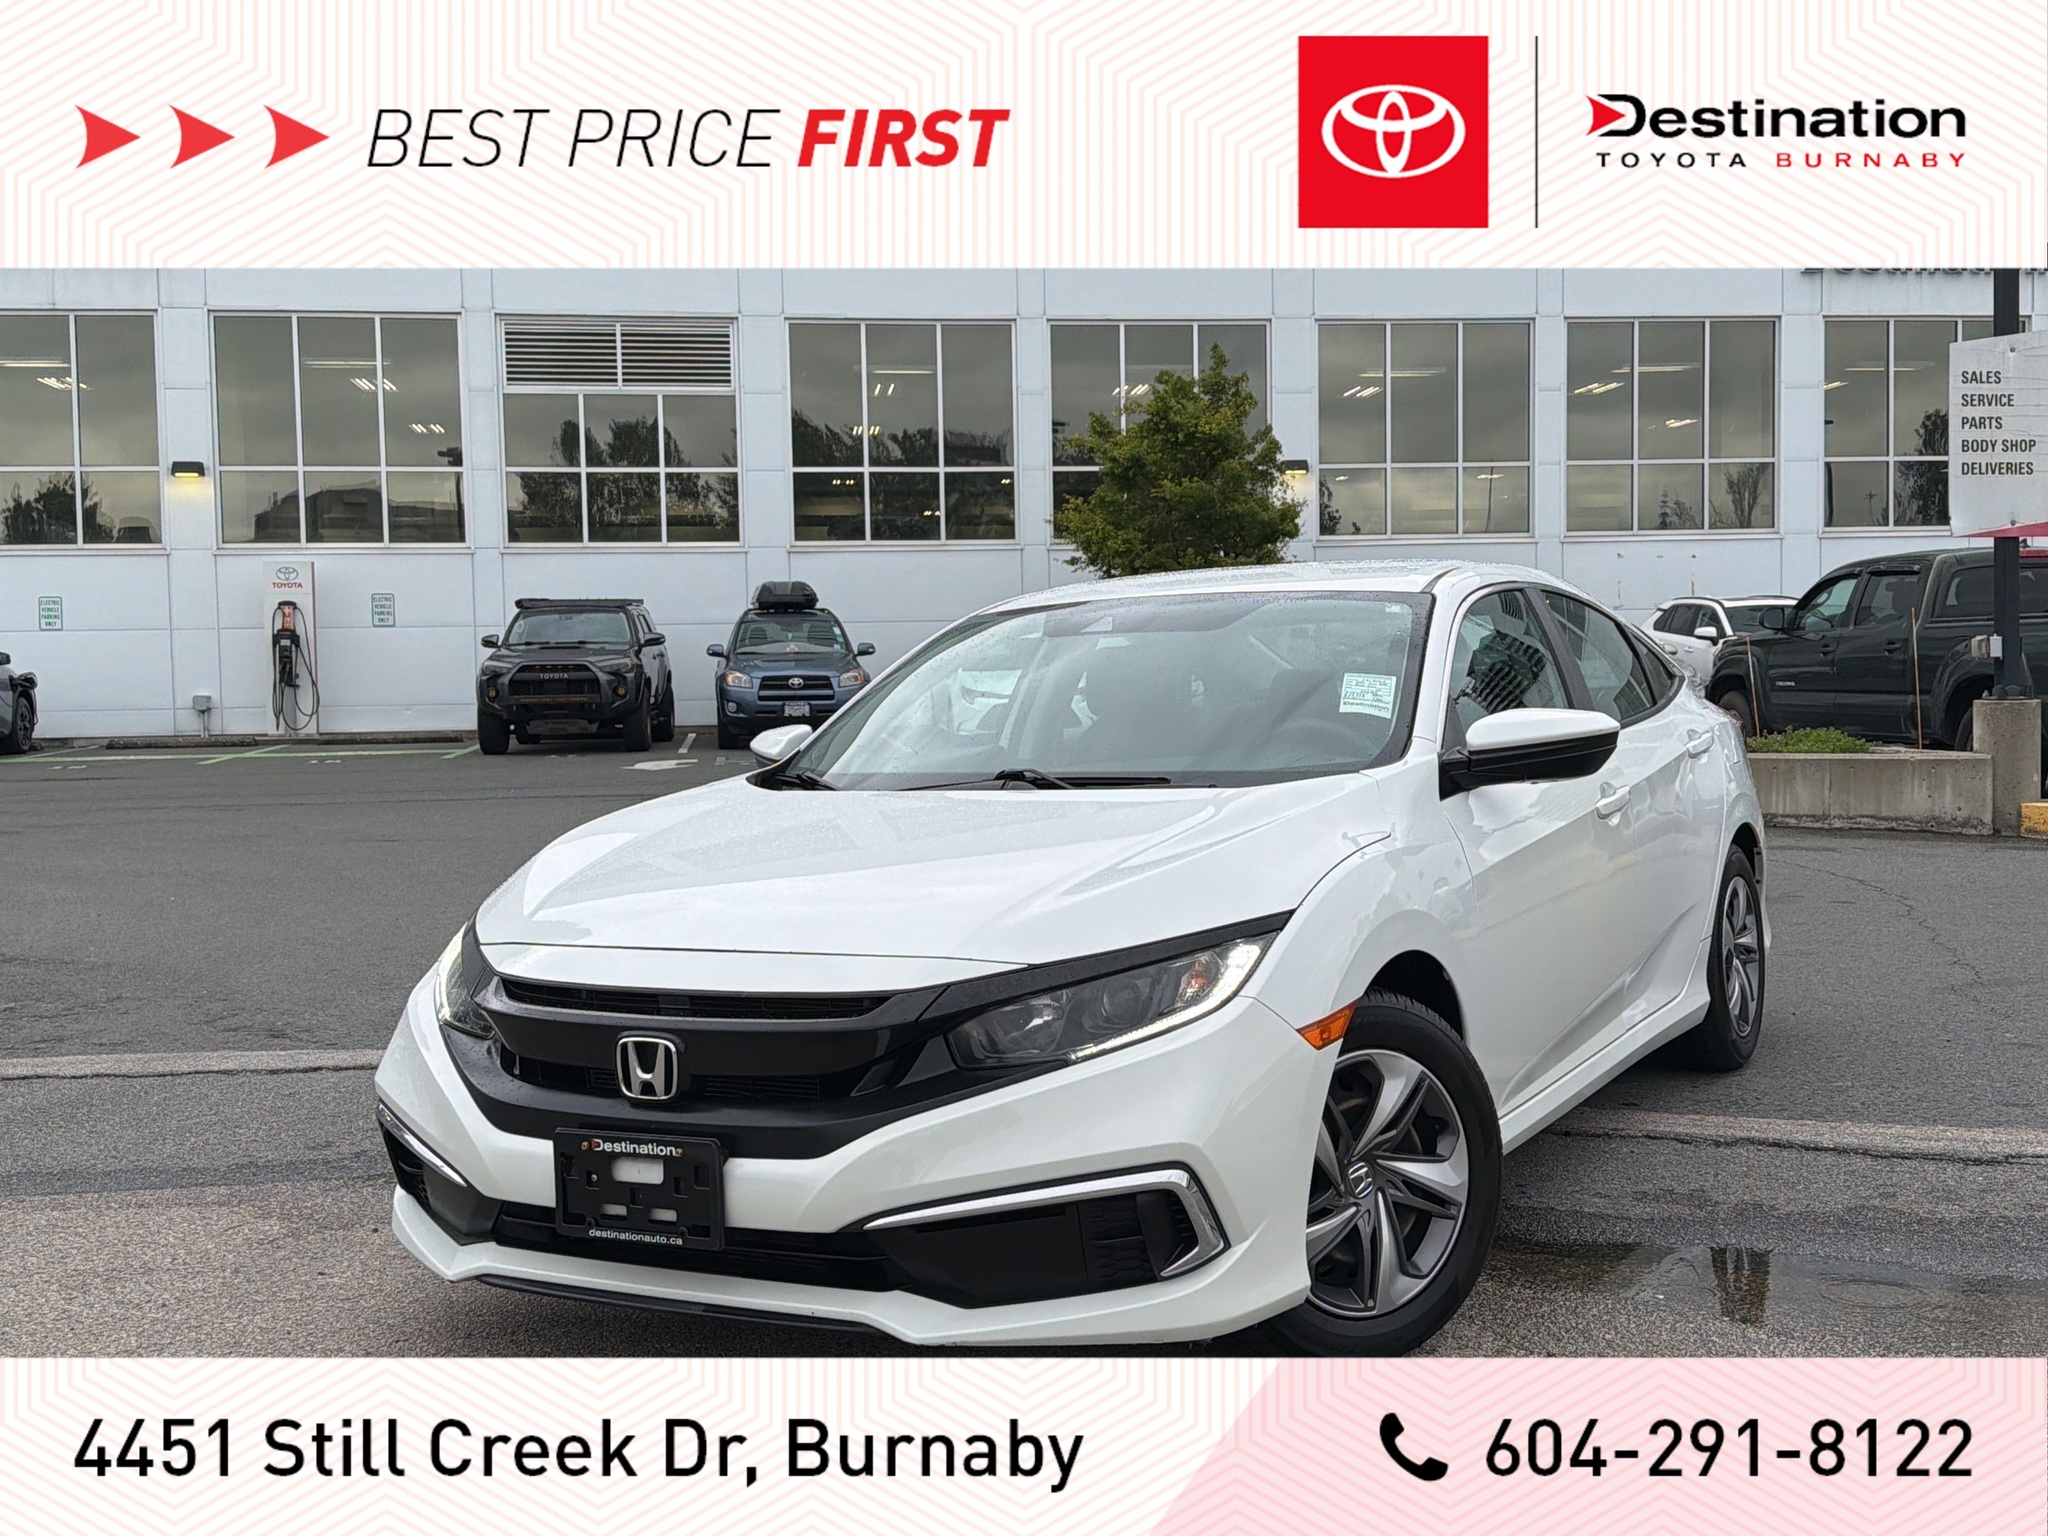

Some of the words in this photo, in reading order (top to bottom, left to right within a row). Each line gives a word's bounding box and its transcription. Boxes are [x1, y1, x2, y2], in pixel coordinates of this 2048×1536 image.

[1961, 370, 2002, 385] SALES
[1961, 393, 2015, 408] SERVICE
[1961, 416, 2003, 430] PARTS
[1961, 439, 1998, 453] BODY
[2001, 439, 2037, 453] SHOP
[1961, 462, 2034, 476] DELIVERIES
[592, 1138, 676, 1156] Destination
[588, 1228, 683, 1246] destinationauto.ca
